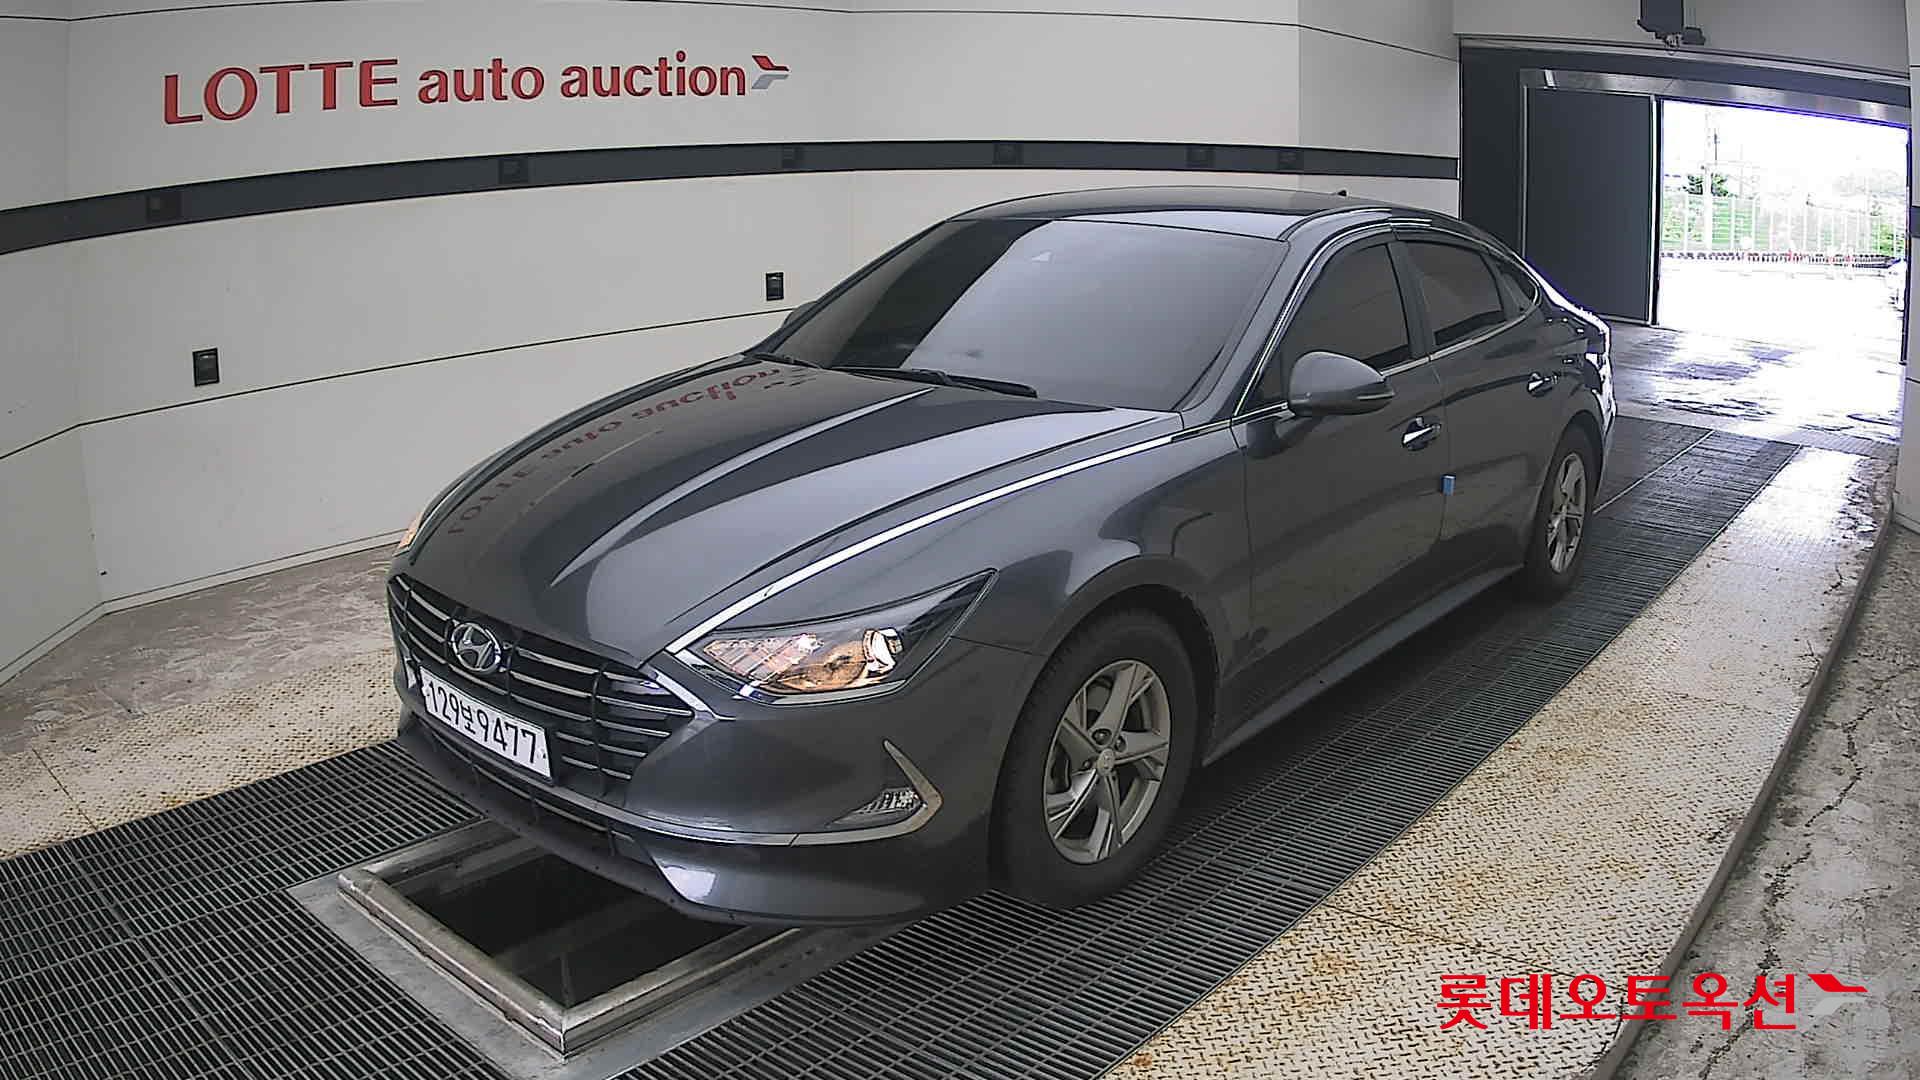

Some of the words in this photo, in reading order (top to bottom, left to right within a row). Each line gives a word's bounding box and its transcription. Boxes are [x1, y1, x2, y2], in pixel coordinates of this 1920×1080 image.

[164, 58, 398, 125] LOTTE
[418, 58, 545, 104] auto
[560, 51, 746, 97] auction
